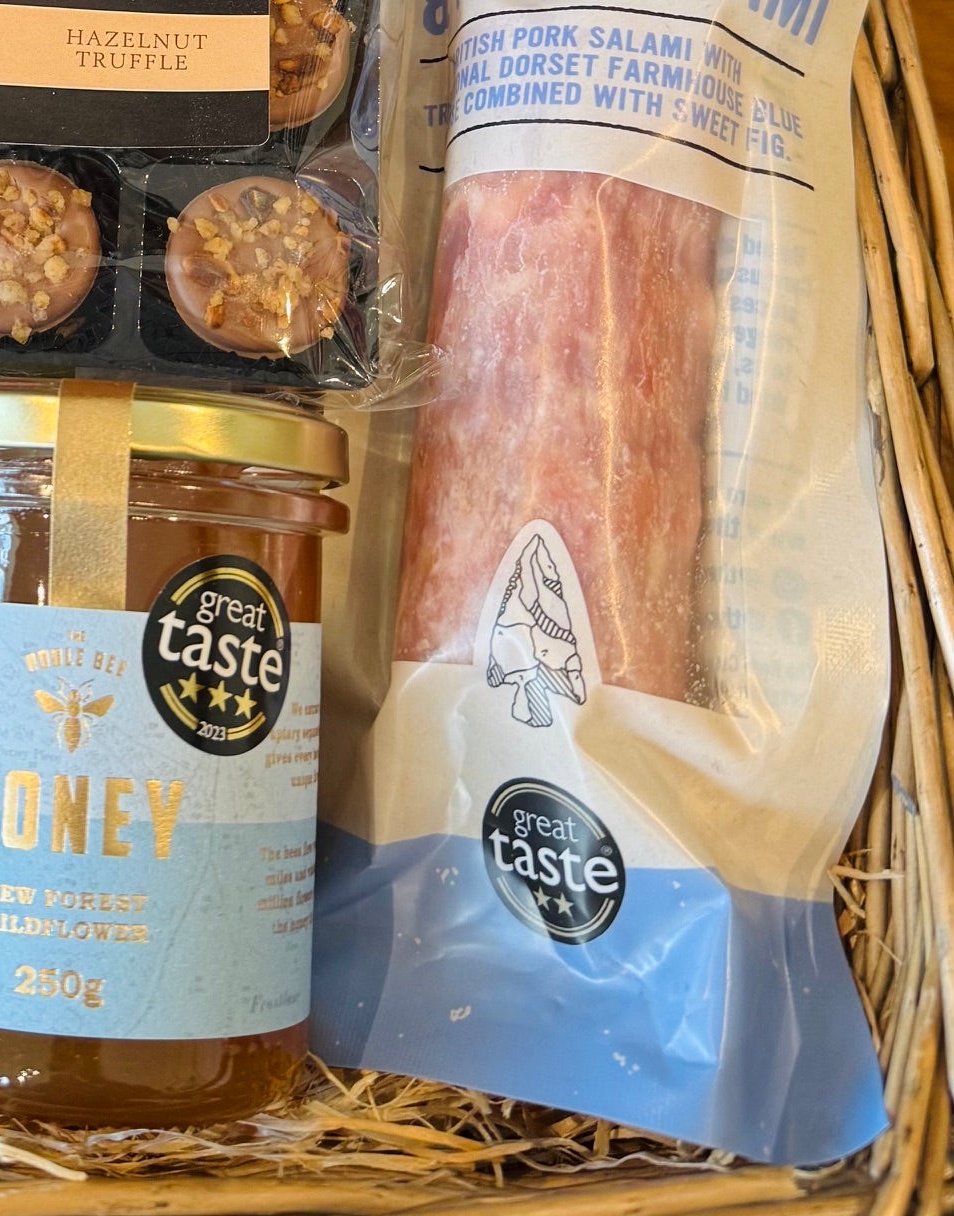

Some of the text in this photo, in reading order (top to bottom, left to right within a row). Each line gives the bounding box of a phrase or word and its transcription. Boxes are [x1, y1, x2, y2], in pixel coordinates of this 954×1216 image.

[66, 28, 208, 50] HAZELNUT
[512, 25, 578, 50] PORK
[589, 28, 692, 62] SALAMI
[704, 42, 742, 85] WITH
[75, 51, 189, 71] TRUFFLE
[499, 53, 599, 79] DORSET
[608, 57, 743, 118] FARMHOUSE
[752, 96, 804, 140] BLUE
[463, 83, 582, 116] COMBINED
[594, 86, 663, 119] WITH
[672, 98, 740, 146] SWEET
[746, 126, 792, 162] FIG.
[196, 590, 267, 632] great
[93, 650, 128, 677] BEE
[158, 610, 283, 693] taste
[197, 721, 226, 741] 2023
[513, 809, 579, 843] great
[488, 828, 619, 894] taste
[44, 889, 149, 912] FOREST
[14, 964, 106, 1009] 250g
